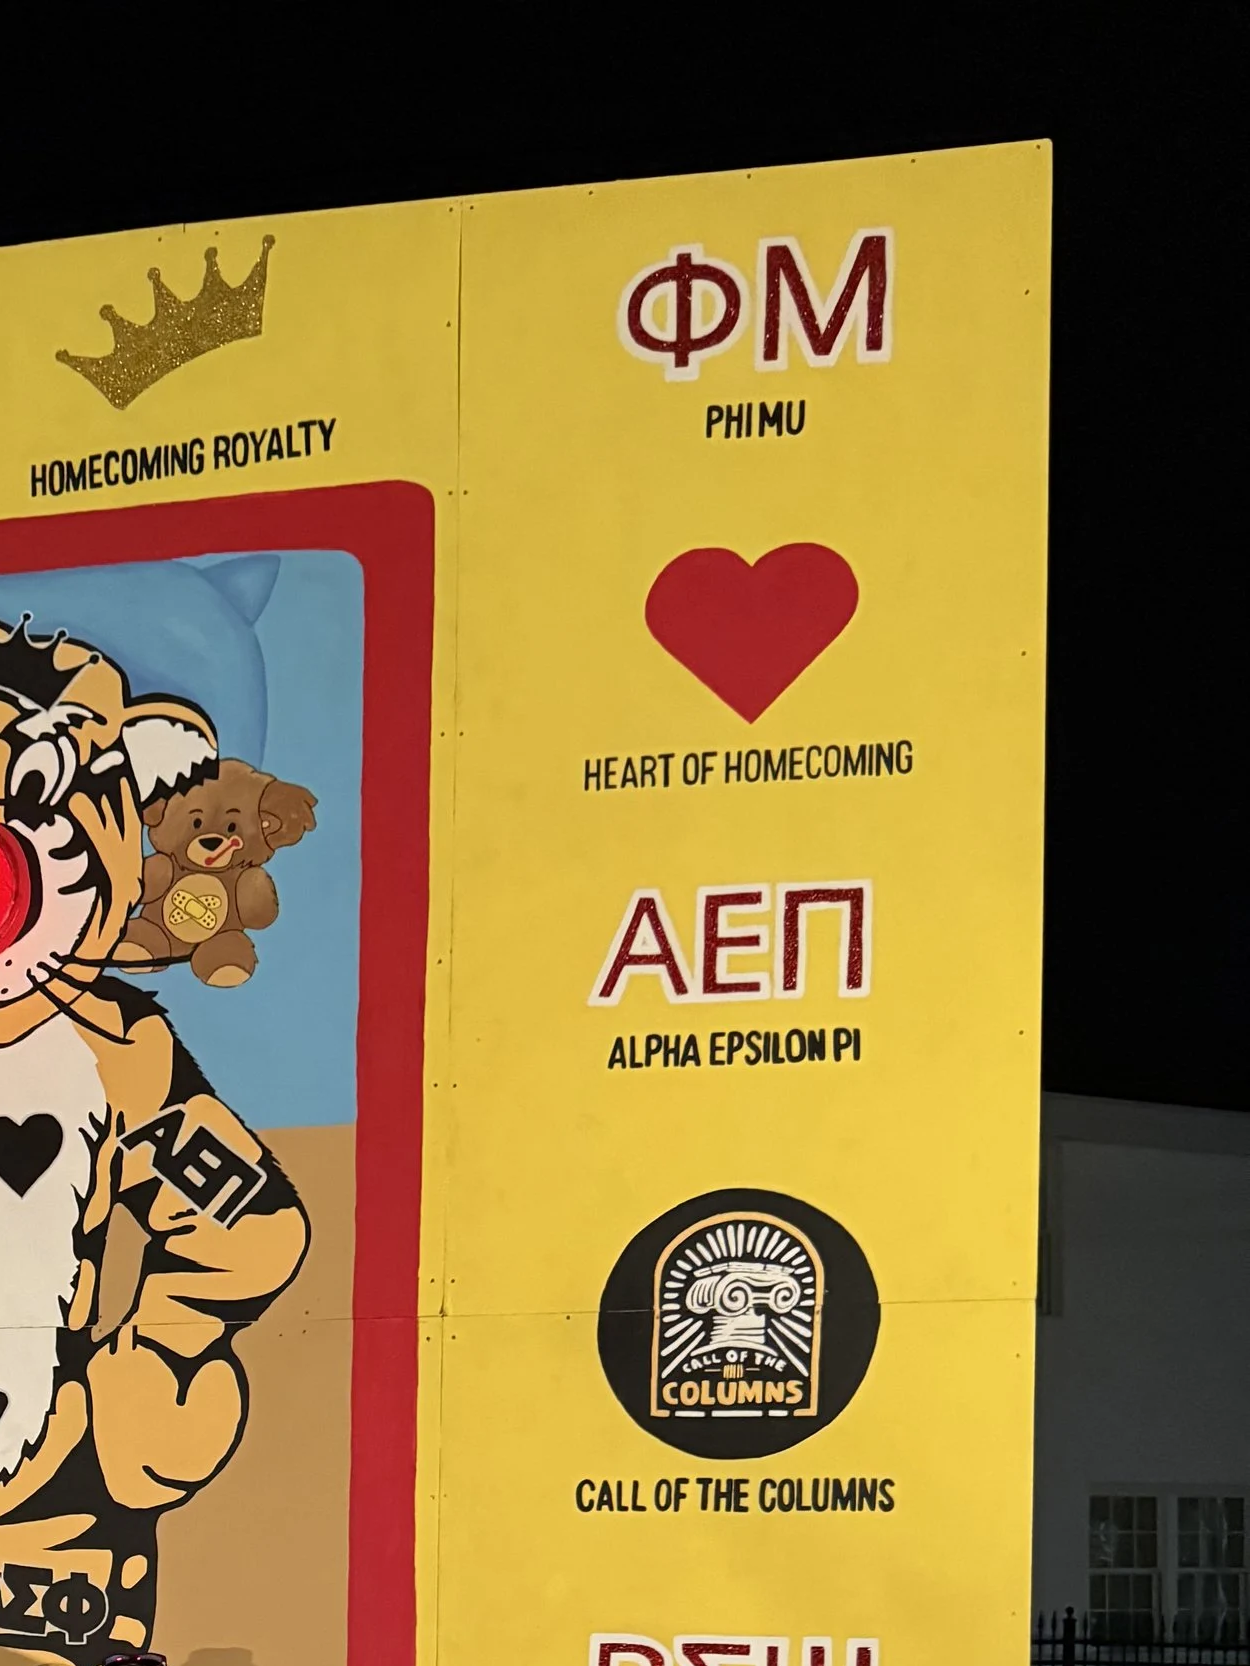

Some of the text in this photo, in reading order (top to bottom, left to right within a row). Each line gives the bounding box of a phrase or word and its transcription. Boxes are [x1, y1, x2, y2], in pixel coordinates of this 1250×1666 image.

[705, 399, 807, 439] PHI MU
[30, 418, 337, 498] HOMECOMING ROYALTY
[583, 740, 914, 791] HEART OF HOMECOMING
[606, 1027, 862, 1070] ALPHA EPSILON PI
[682, 1349, 787, 1373] CALL OF THE
[662, 1379, 804, 1406] COLUMNS
[574, 1476, 896, 1514] CALL OF THE COLUMNS
